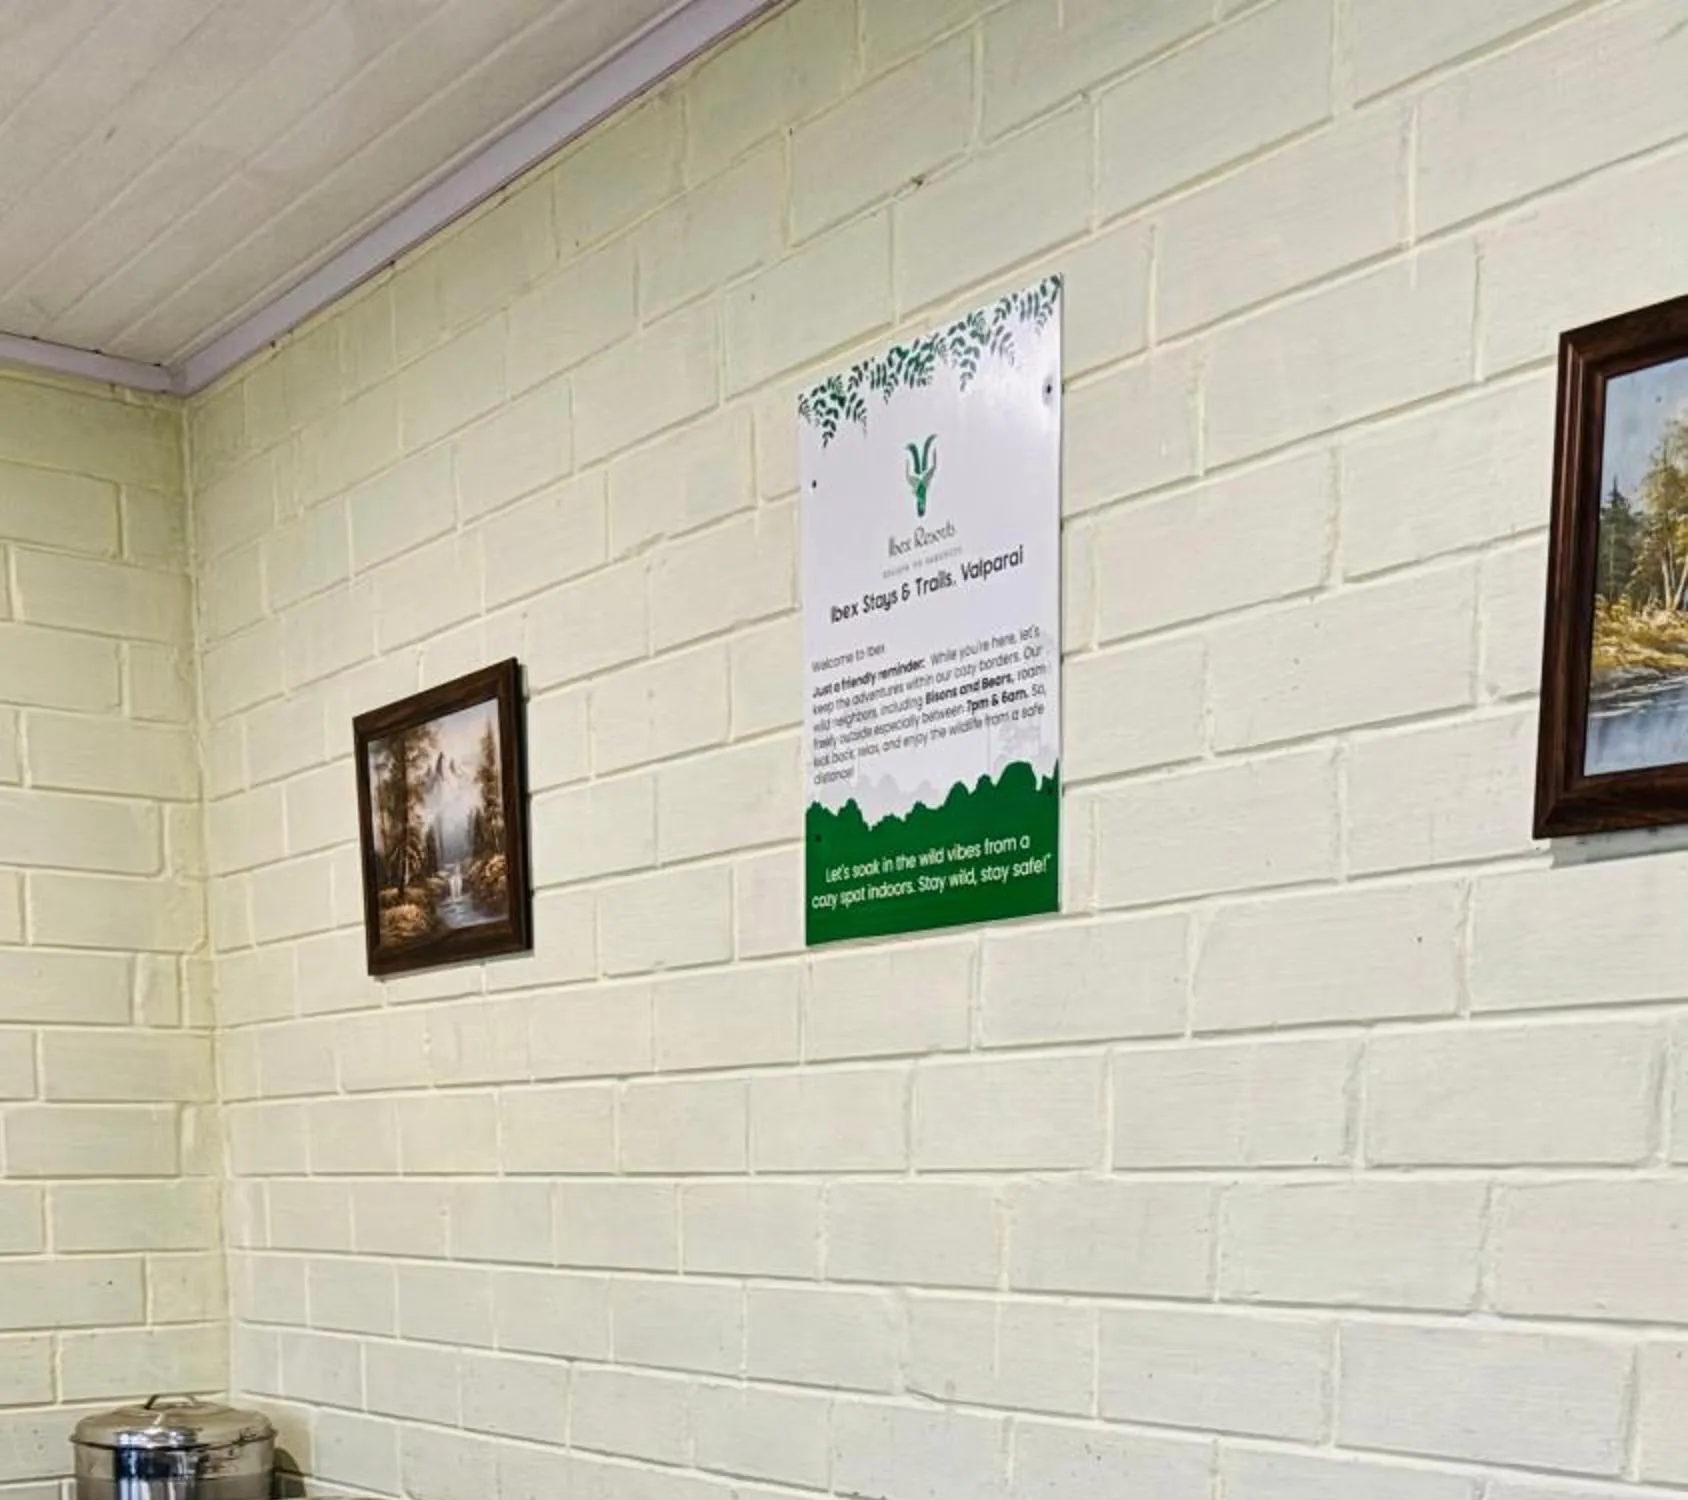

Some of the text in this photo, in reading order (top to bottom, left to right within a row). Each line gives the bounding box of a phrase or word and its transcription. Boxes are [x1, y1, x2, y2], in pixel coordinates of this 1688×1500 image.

[830, 602, 859, 625] Ibex
[863, 589, 898, 614] Stays
[901, 581, 911, 601] &
[961, 543, 1023, 582] Valparai
[811, 651, 854, 673] Welcome
[812, 682, 832, 699] Just
[833, 682, 841, 693] a
[841, 671, 877, 691] friendly
[930, 648, 957, 666] While
[1019, 623, 1041, 641] let's
[813, 701, 834, 717] keep
[835, 696, 850, 709] the
[851, 682, 904, 707] adventures
[905, 673, 934, 691] within
[935, 669, 953, 683] our
[953, 663, 977, 680] cozy
[1023, 645, 1044, 660] Our
[813, 718, 831, 732] wild
[880, 696, 923, 716] including
[925, 686, 957, 705] Bisons
[959, 679, 980, 695] and
[1017, 664, 1046, 681] roam
[874, 714, 919, 736] especially
[921, 704, 964, 724] between
[966, 698, 989, 715] 7pm
[991, 693, 999, 706] &
[882, 736, 901, 752] and
[903, 731, 928, 748] enjoy
[930, 726, 947, 740] the
[949, 717, 982, 736] wildlife
[984, 711, 1009, 727] from
[1011, 708, 1019, 721] a
[1021, 702, 1045, 719] safe
[825, 834, 1031, 884] Let's soak in the wild vibes from a
[811, 893, 838, 911] cozy
[840, 887, 866, 909] spot
[917, 874, 947, 895] Stay
[948, 866, 978, 888] wild,
[980, 865, 1010, 885] stay
